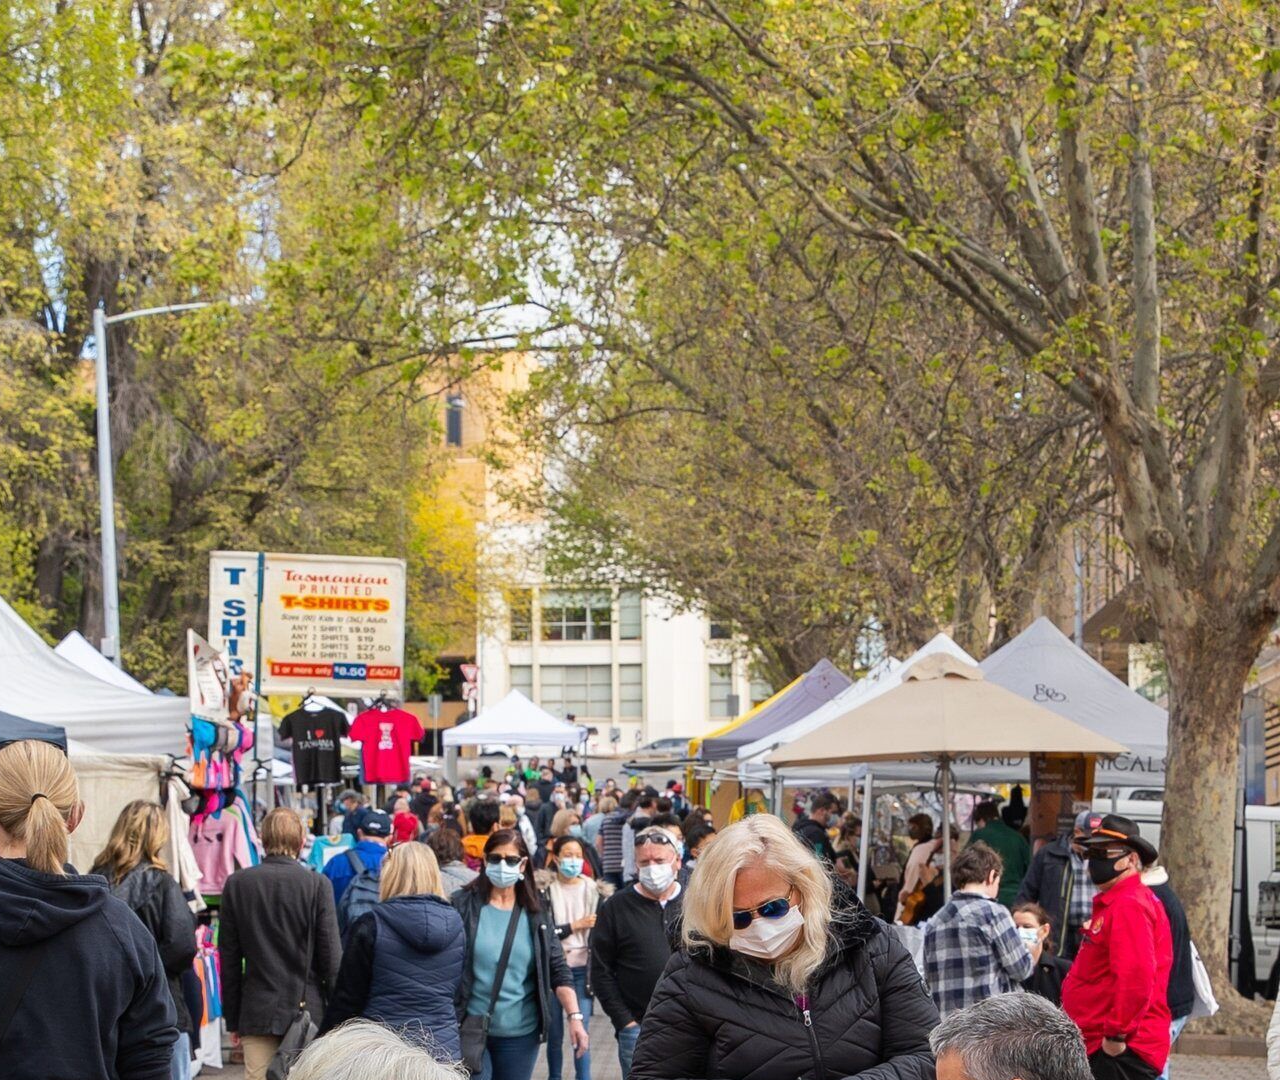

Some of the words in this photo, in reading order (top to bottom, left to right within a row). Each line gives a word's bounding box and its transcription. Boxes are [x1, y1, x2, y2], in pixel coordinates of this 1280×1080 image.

[223, 567, 246, 585] T
[283, 570, 389, 585] Tasmanian
[299, 584, 373, 596] PRINTED
[281, 595, 390, 611] T-SHIRTS
[366, 615, 388, 624] Adults
[290, 624, 308, 632] ANY
[320, 624, 343, 633] SHIRT
[348, 625, 376, 634] $9.95
[290, 633, 308, 641] ANY
[321, 634, 349, 642] SHIRTS
[357, 635, 374, 643] $19
[290, 642, 308, 650] ANY
[321, 642, 349, 651] SHIRTS
[357, 643, 391, 652] $27.50
[290, 650, 308, 658] ANY
[320, 651, 348, 660] SHIRTS
[357, 652, 375, 661] $35
[273, 665, 280, 673] 5
[293, 667, 312, 675] more
[315, 667, 332, 677] only
[334, 665, 366, 677] $8.50
